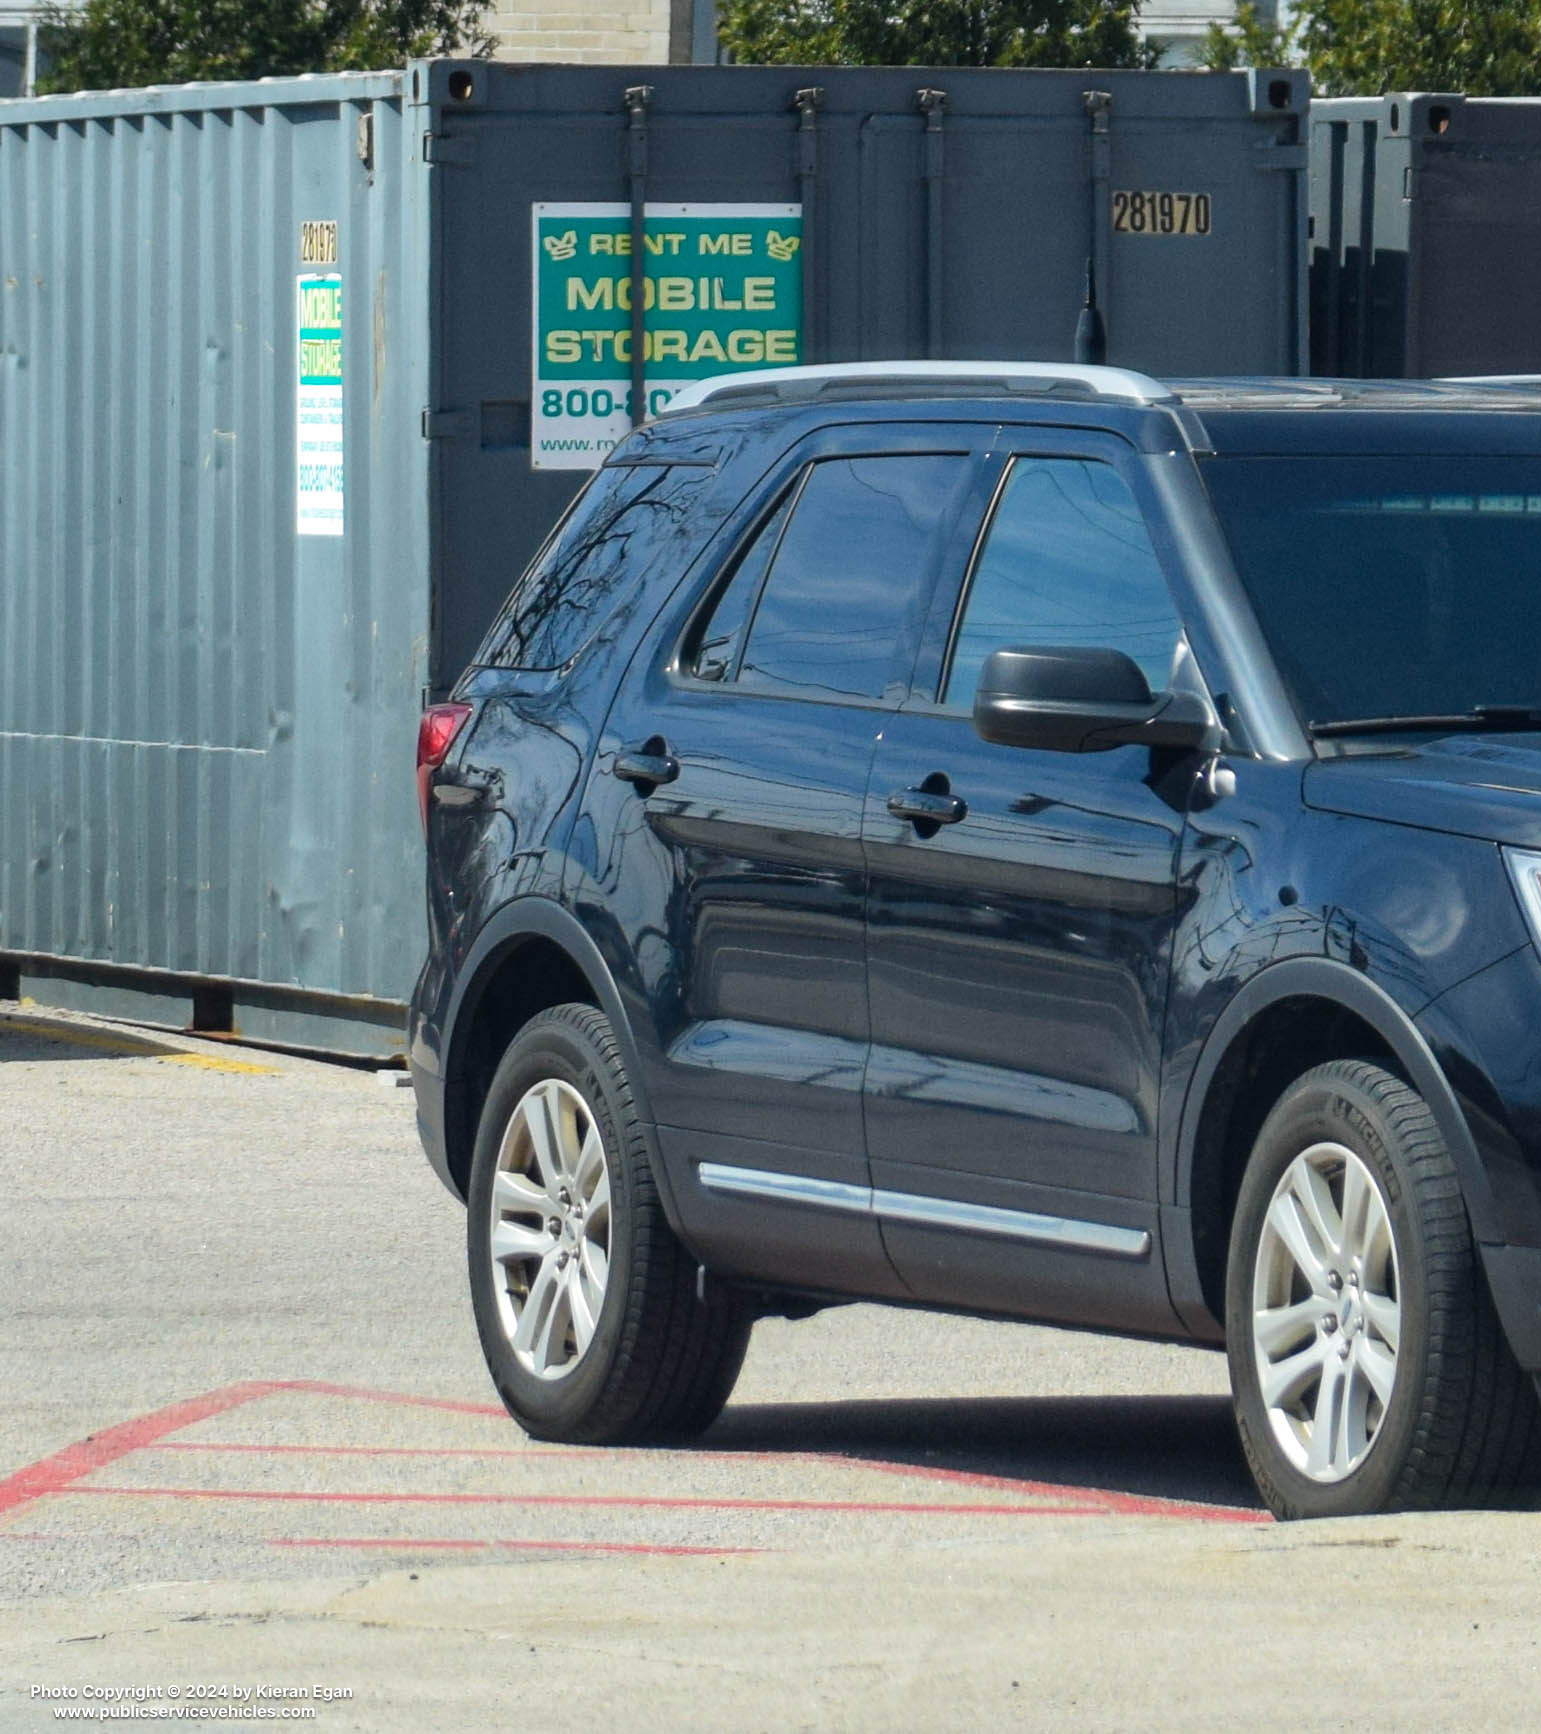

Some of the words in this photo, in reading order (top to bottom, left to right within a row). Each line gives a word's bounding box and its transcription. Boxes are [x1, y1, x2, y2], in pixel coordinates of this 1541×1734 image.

[1115, 191, 1210, 233] 281970
[303, 222, 337, 261] 281970
[589, 233, 687, 256] RENT
[699, 233, 752, 256] ME
[301, 288, 342, 328] MOBILE
[566, 277, 776, 311] MOBILE
[546, 329, 798, 363] STORAGE
